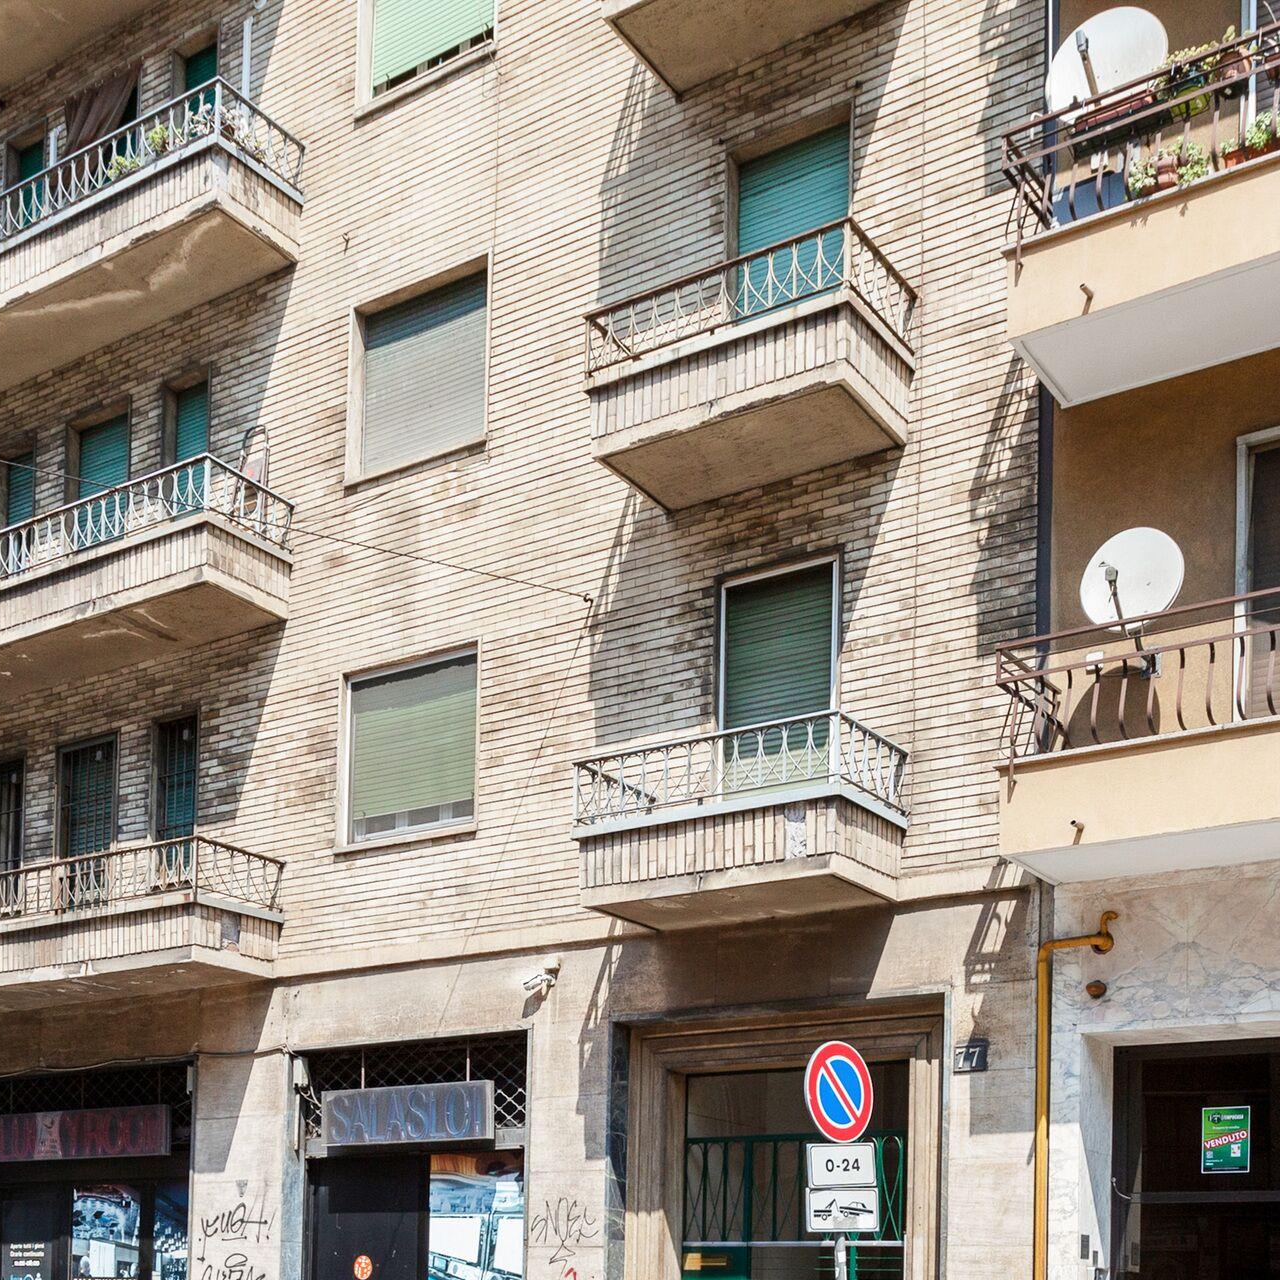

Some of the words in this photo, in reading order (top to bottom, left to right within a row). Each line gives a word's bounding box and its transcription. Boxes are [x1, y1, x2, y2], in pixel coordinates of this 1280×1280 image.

[955, 1047, 980, 1069] 77
[1204, 1130, 1248, 1149] VENDUTO
[825, 1158, 861, 1173] 0-24
